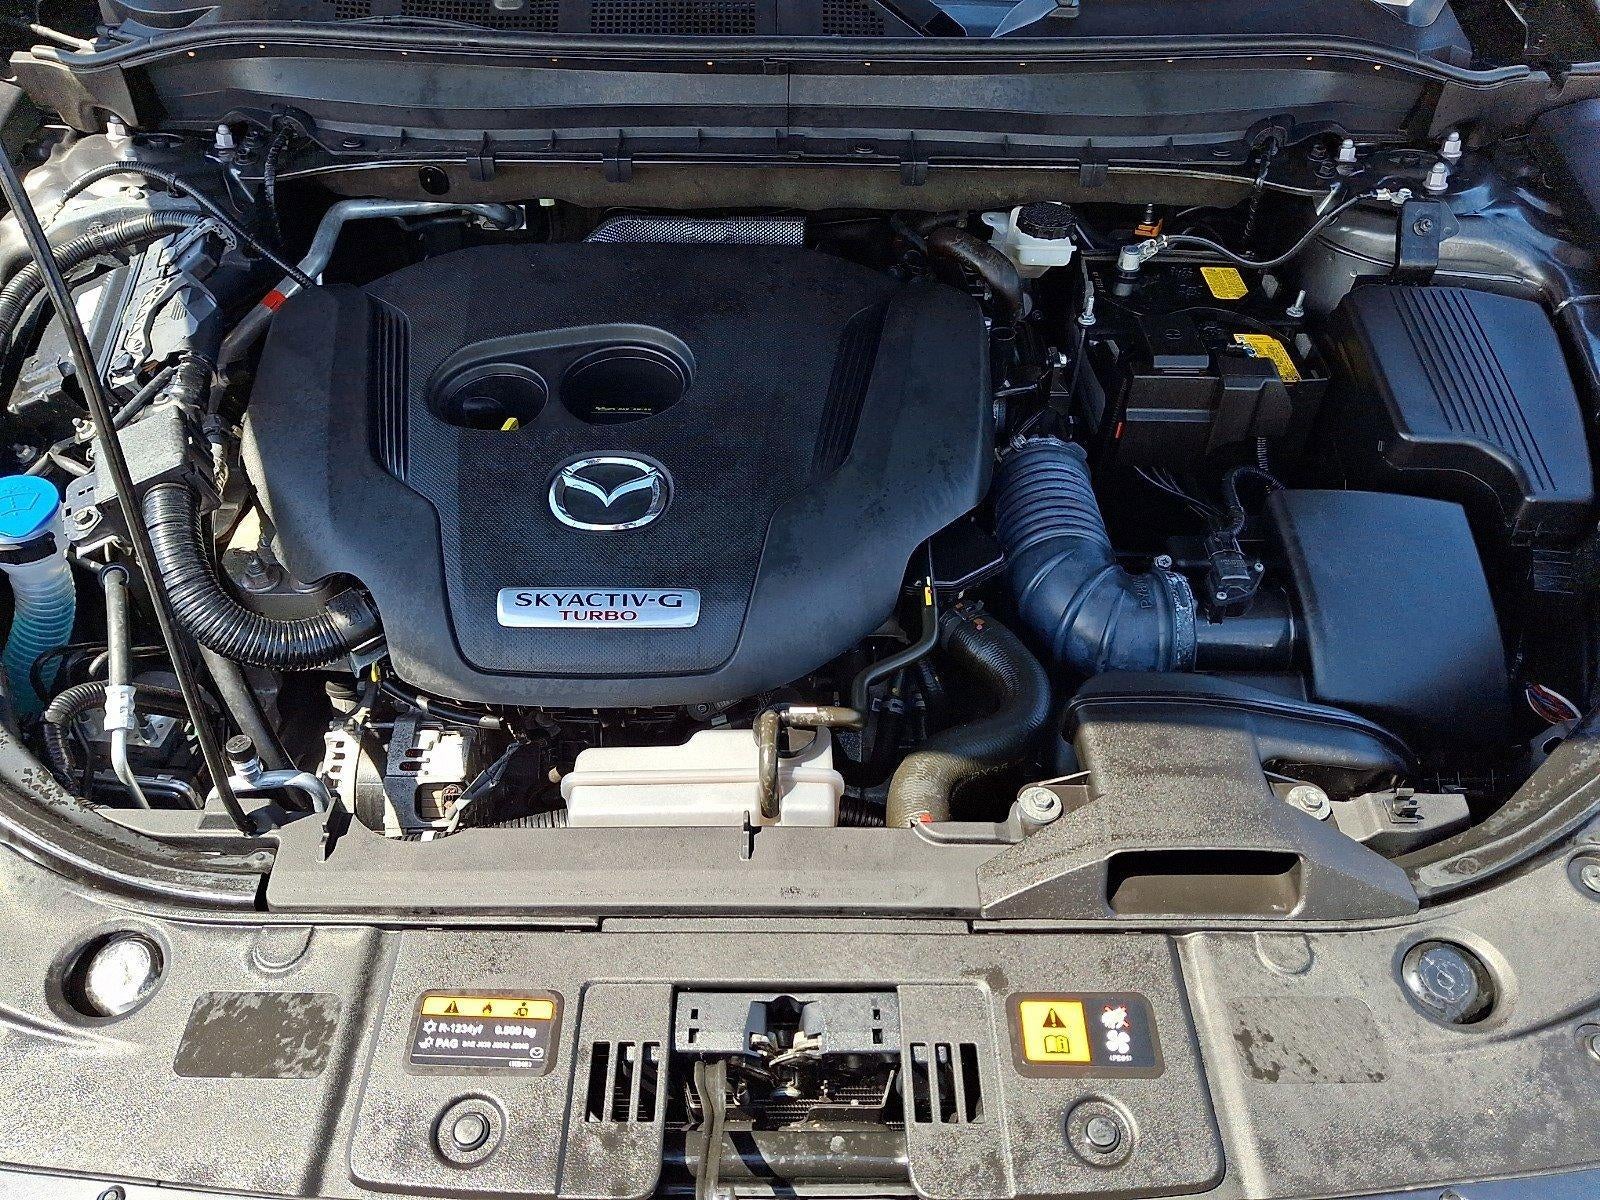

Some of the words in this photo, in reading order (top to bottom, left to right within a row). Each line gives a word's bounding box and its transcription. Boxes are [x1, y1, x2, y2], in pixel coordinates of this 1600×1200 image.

[514, 593, 683, 608] SKYACTIV-G
[558, 610, 638, 621] TURBO
[438, 1022, 484, 1036] R-1234yf
[435, 1038, 459, 1049] PAG
